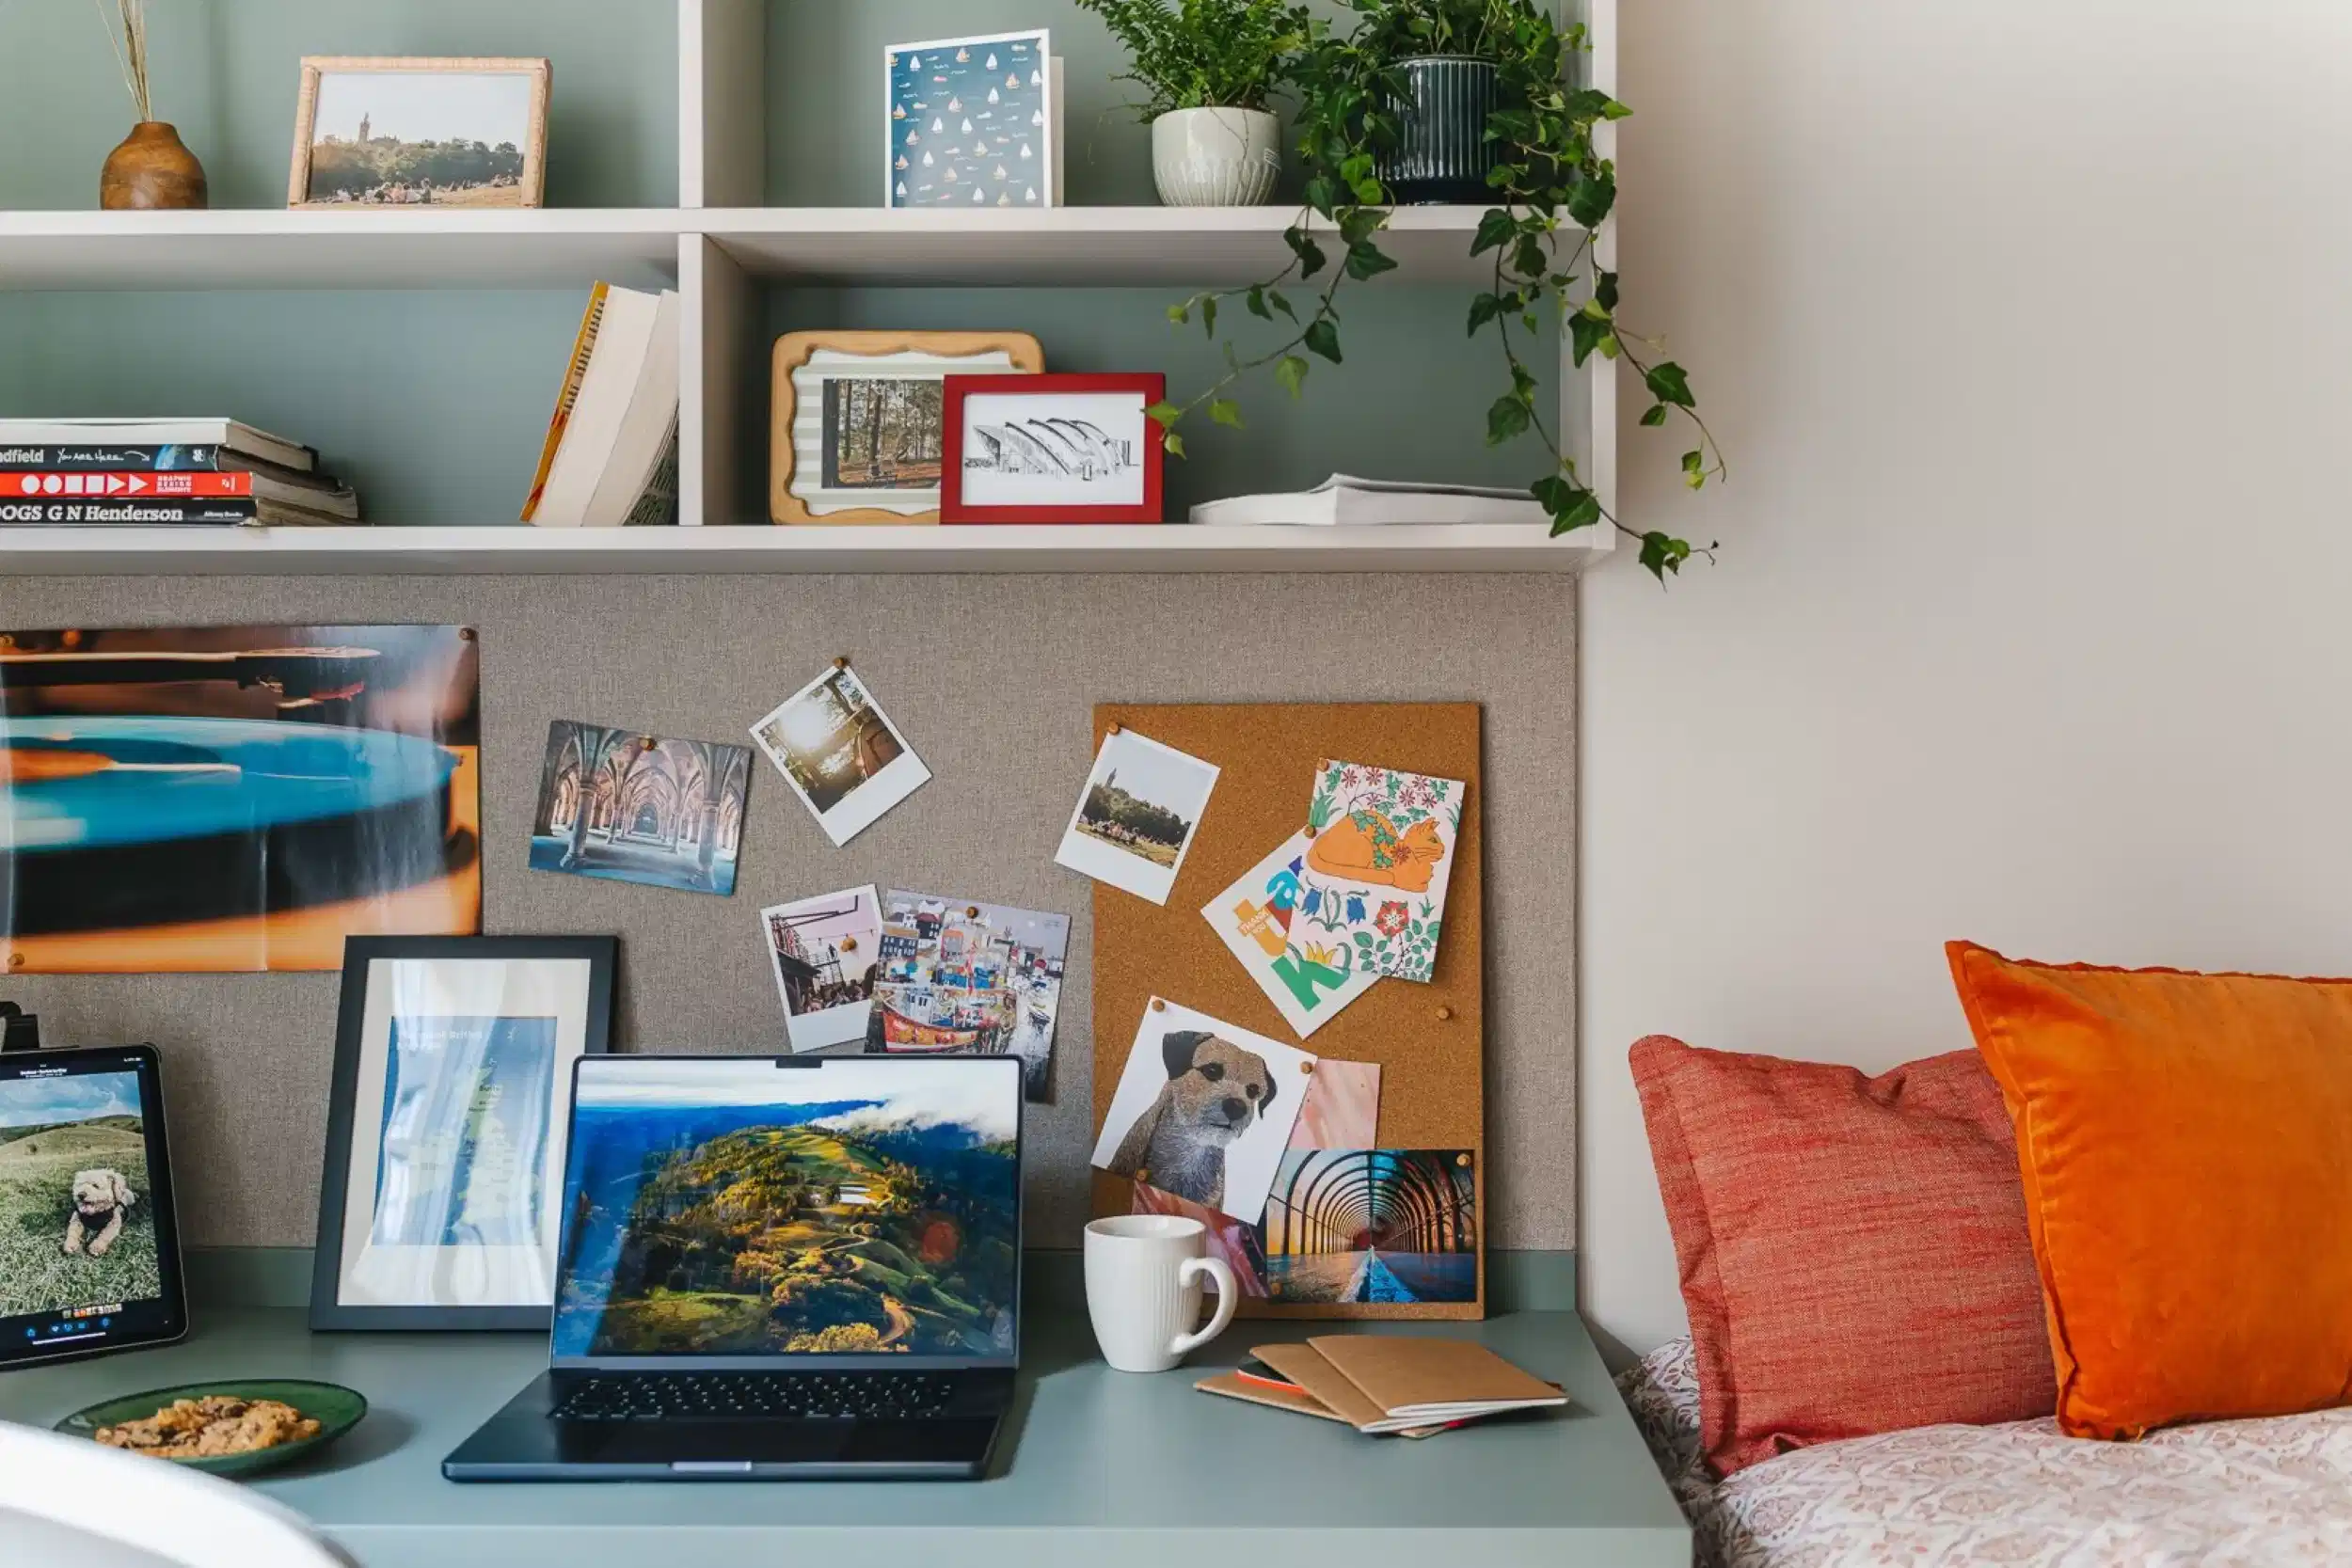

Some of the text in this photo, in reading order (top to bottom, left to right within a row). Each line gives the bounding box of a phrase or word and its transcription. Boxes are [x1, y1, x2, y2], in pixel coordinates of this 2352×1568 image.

[0, 504, 183, 521] OGS G N Henderson
